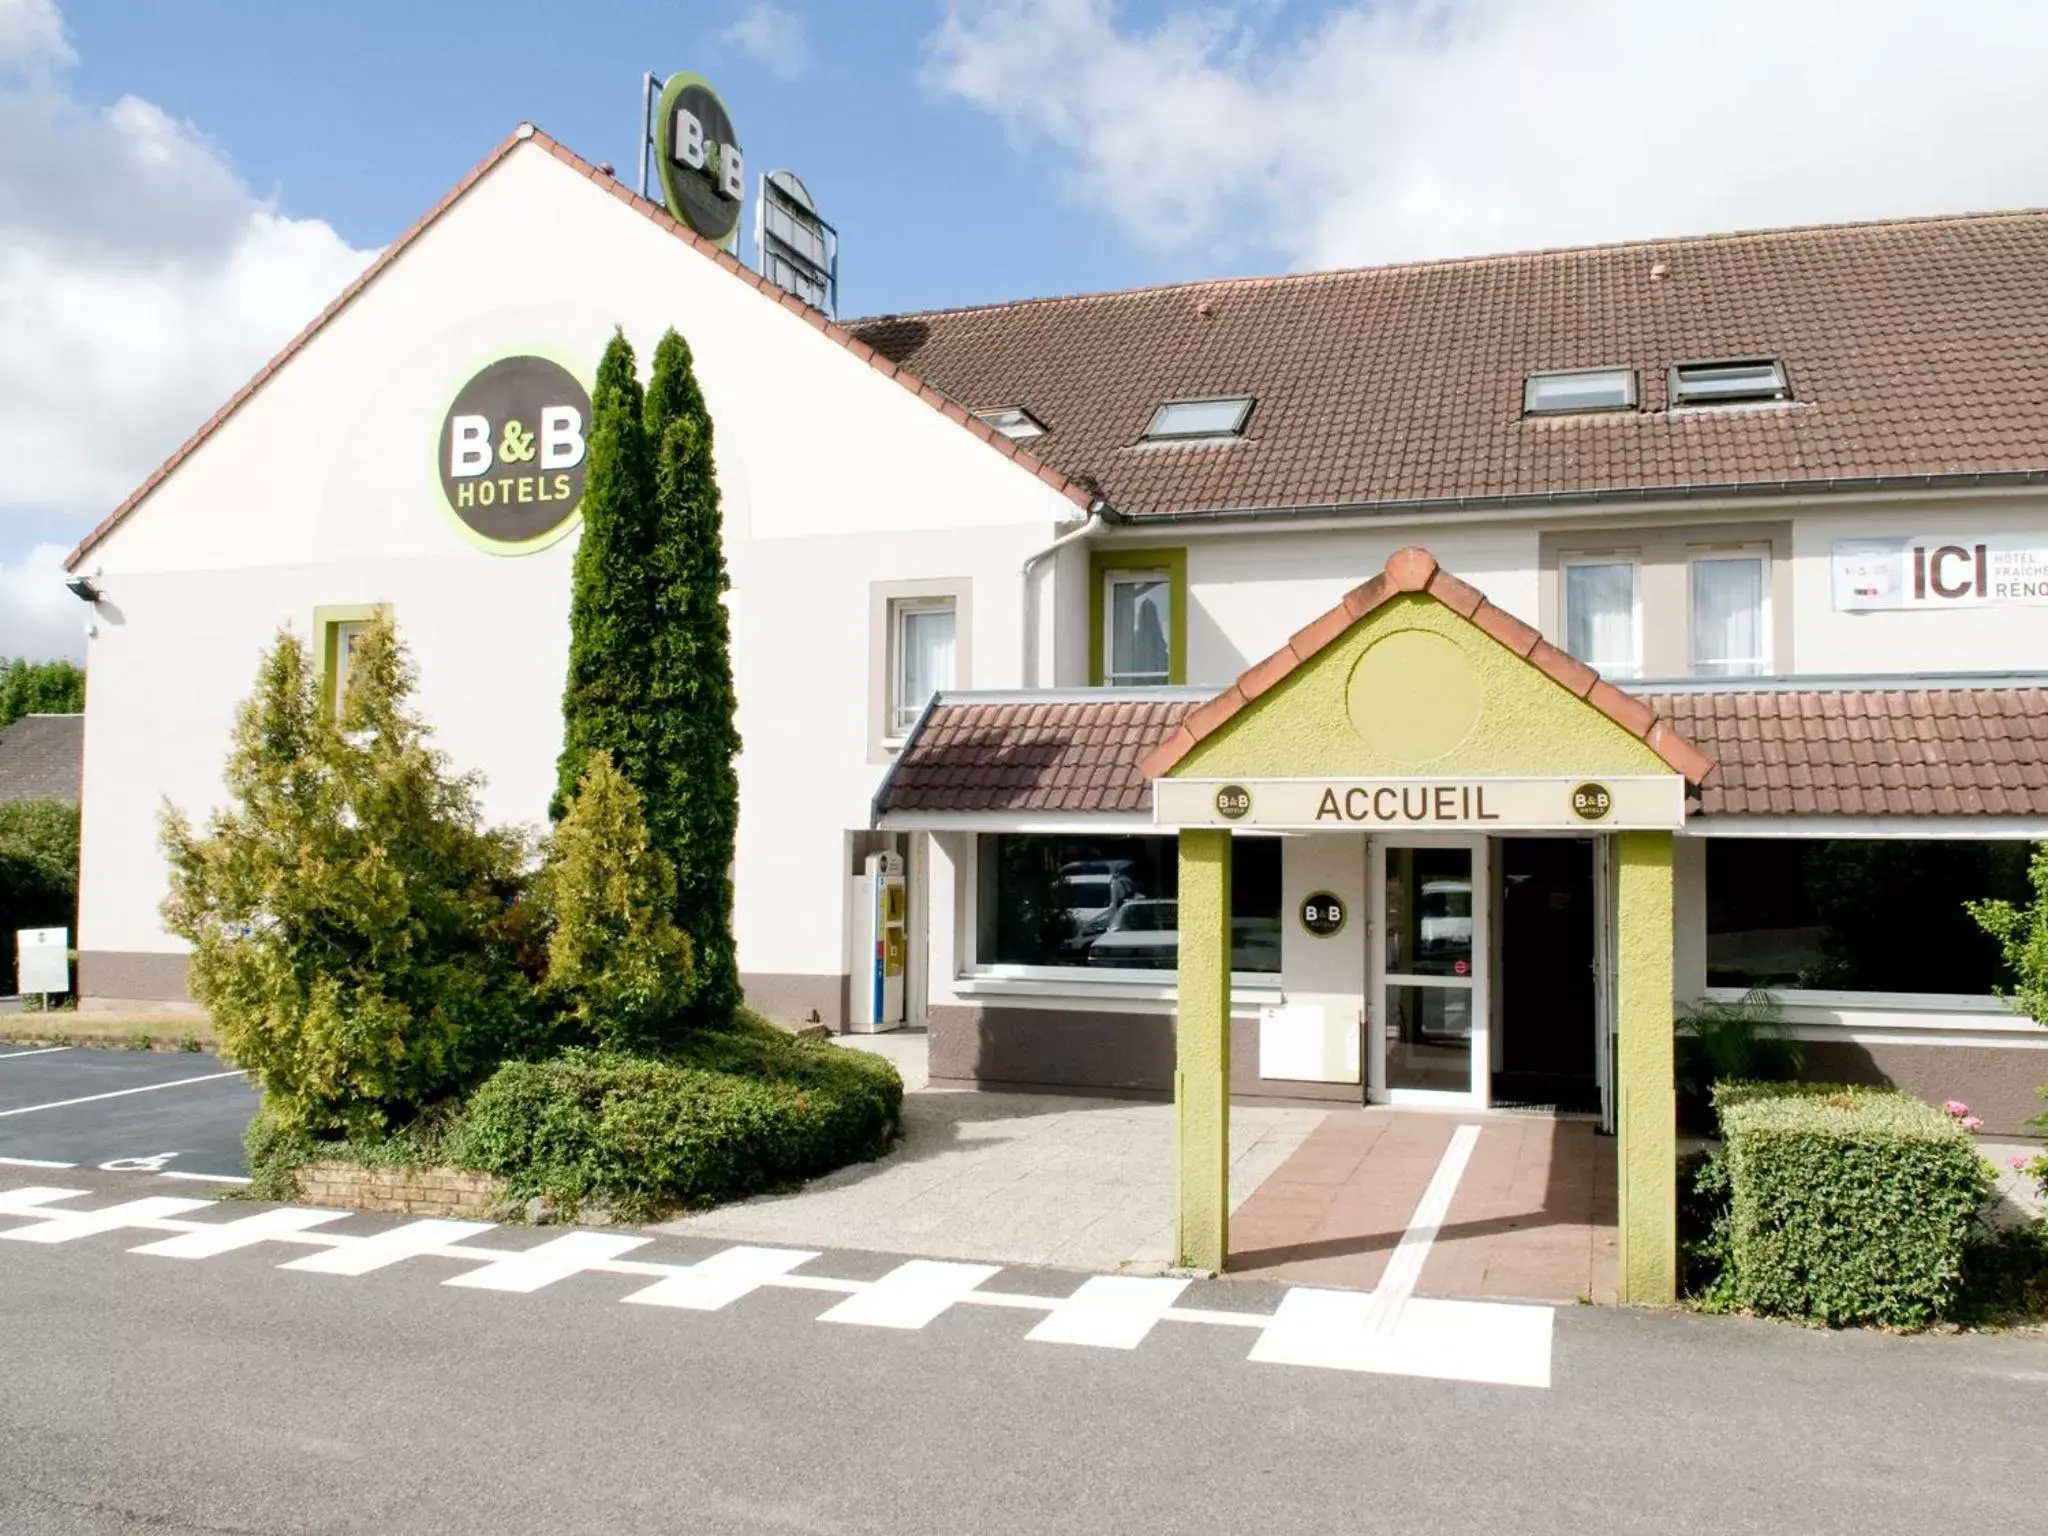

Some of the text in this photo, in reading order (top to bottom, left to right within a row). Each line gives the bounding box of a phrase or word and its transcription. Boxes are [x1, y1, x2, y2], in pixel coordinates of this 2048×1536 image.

[451, 405, 585, 477] B&B
[458, 474, 571, 507] HOTELS
[1913, 544, 1987, 599] ICI
[1315, 786, 1500, 821] ACCUEIL
[1575, 794, 1609, 808] B&B
